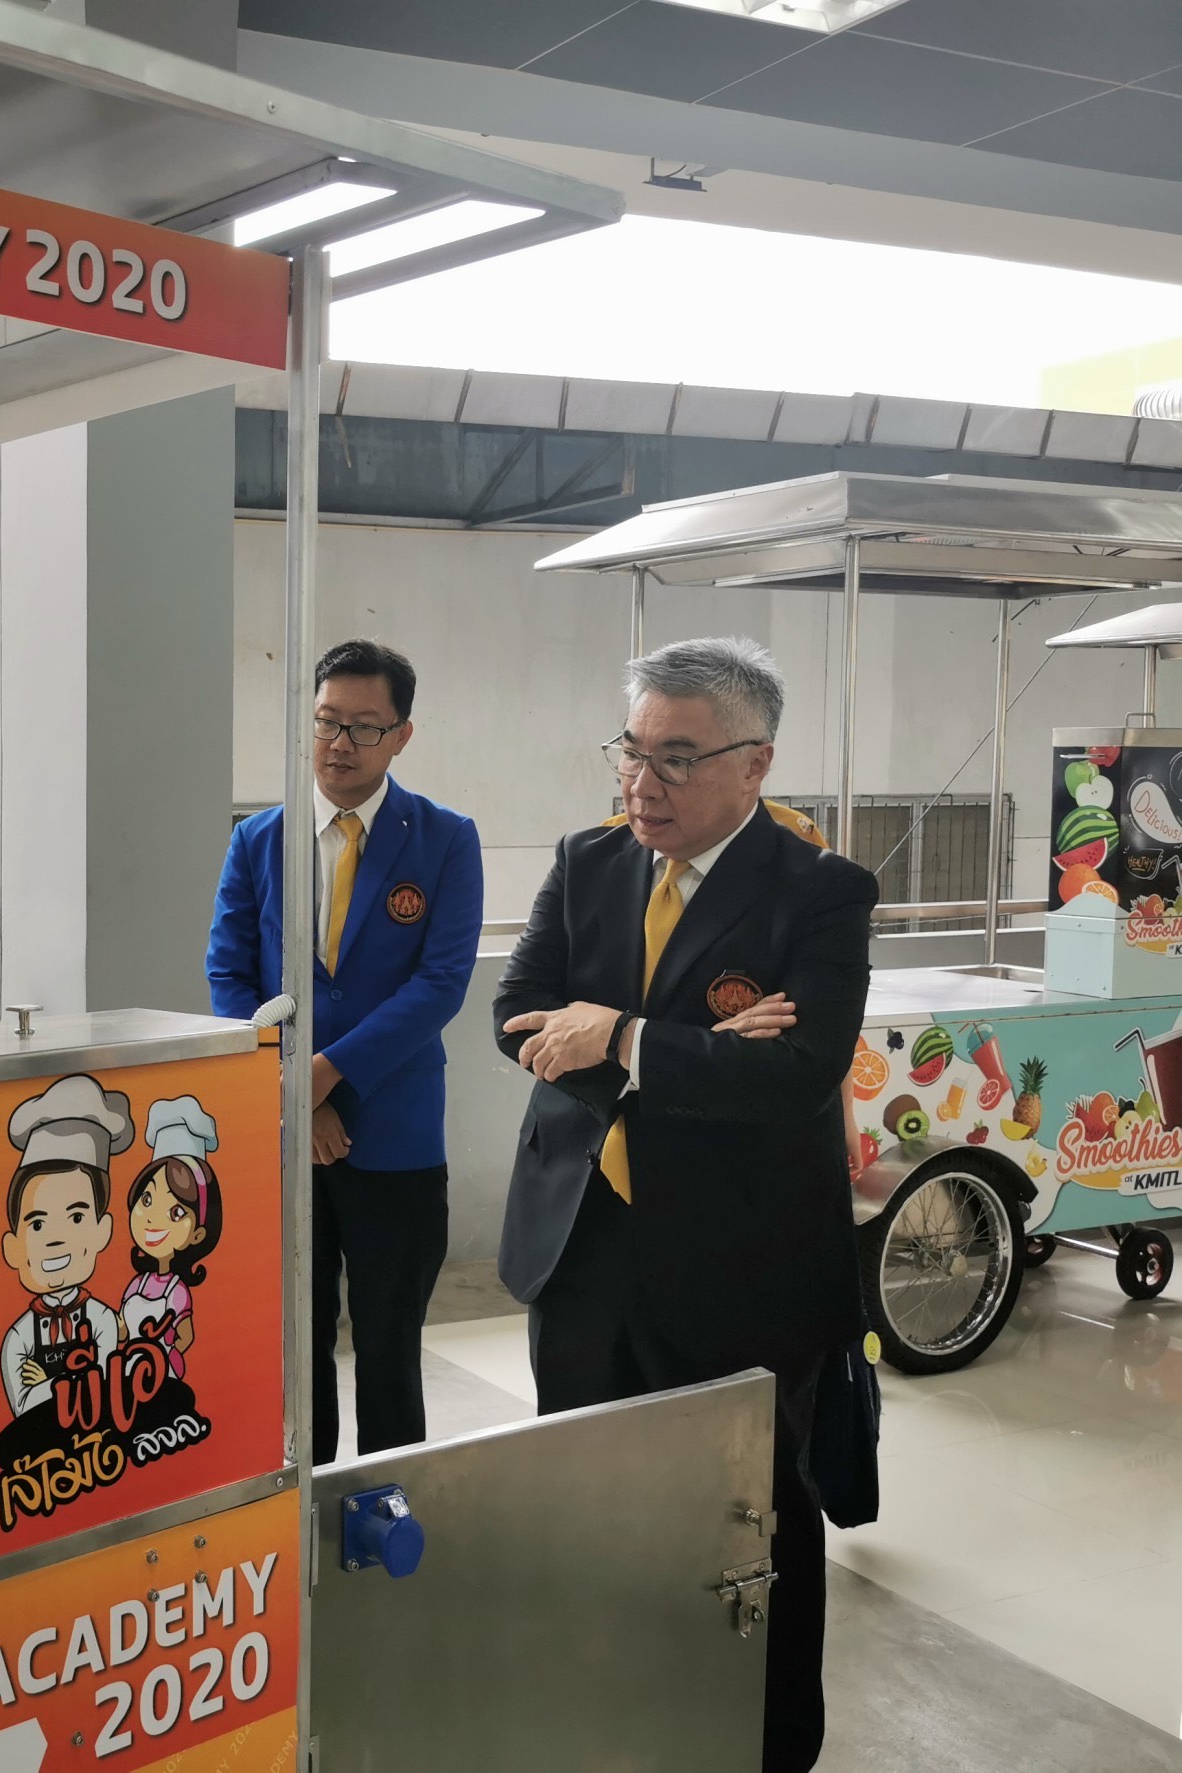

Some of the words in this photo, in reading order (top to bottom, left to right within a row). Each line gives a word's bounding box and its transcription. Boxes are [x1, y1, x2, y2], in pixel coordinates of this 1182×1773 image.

[24, 228, 187, 321] 2020
[1056, 1118, 1182, 1175] Smoothies
[1133, 1169, 1182, 1191] KMITL
[93, 1631, 270, 1758] 2020
